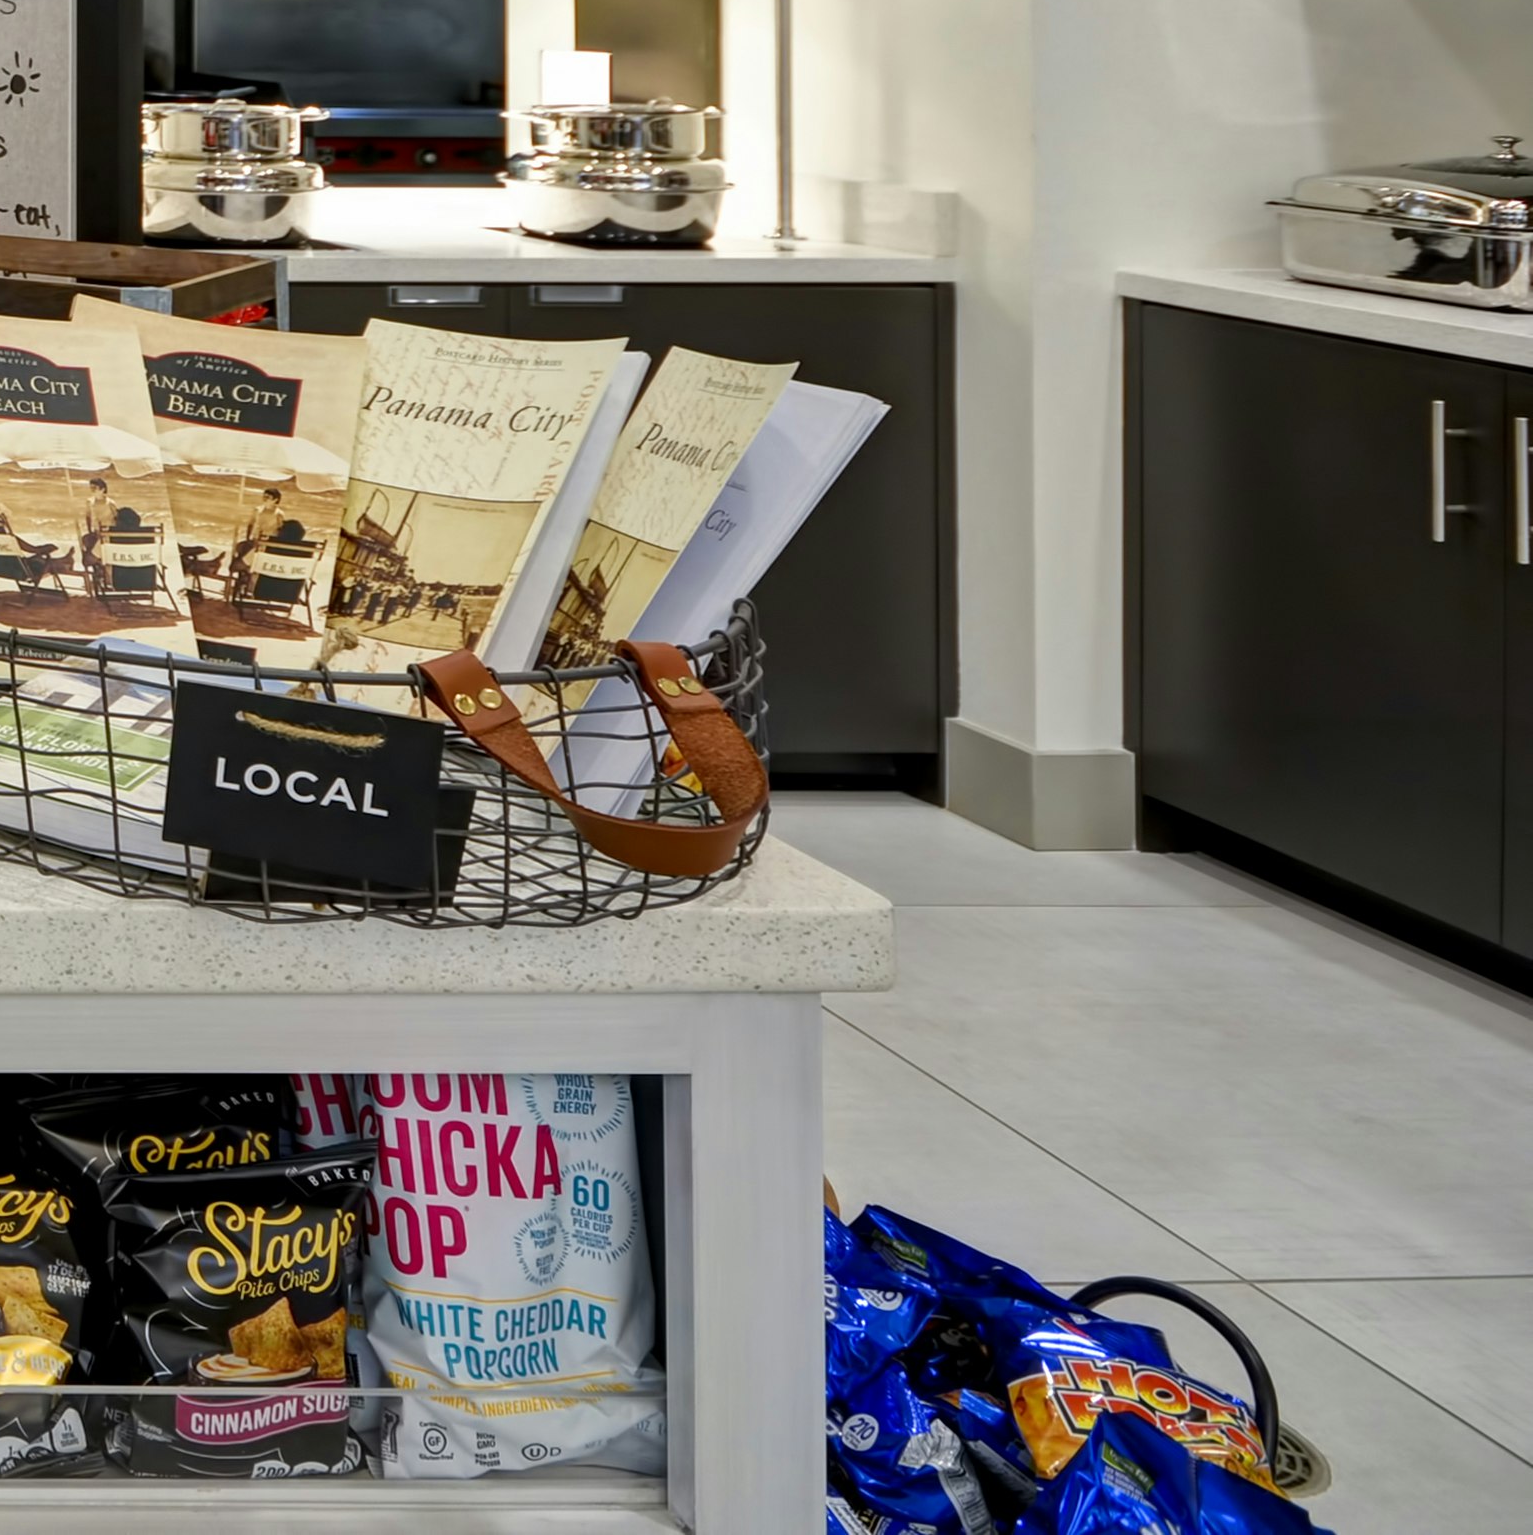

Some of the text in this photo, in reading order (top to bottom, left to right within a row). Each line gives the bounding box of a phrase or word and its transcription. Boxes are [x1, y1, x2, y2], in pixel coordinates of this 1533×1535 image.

[30, 375, 80, 396] CITY
[145, 373, 288, 407] ANAMA CITY
[167, 394, 242, 423] BEACH
[362, 385, 575, 442] Panama City
[635, 423, 711, 468] Panama
[705, 509, 736, 542] City
[214, 756, 390, 818] LOCAL
[554, 1074, 595, 1089] WHOLE
[557, 1088, 593, 1102] GRAIN
[553, 1101, 597, 1116] ENERGY
[308, 1167, 371, 1188] BAKED
[572, 1174, 610, 1212] 60
[570, 1207, 613, 1225] CALORIES
[572, 1218, 611, 1234] PER CUP
[187, 1201, 357, 1295] Stacy's
[237, 1268, 321, 1300] Pita Chips
[396, 1296, 608, 1343] WHITE CHEDDAR
[444, 1337, 561, 1382] POPCORN
[1067, 1359, 1240, 1424] HOT
[190, 1399, 298, 1436] CINNAMON
[849, 1420, 875, 1442] 210
[428, 1435, 442, 1447] GF
